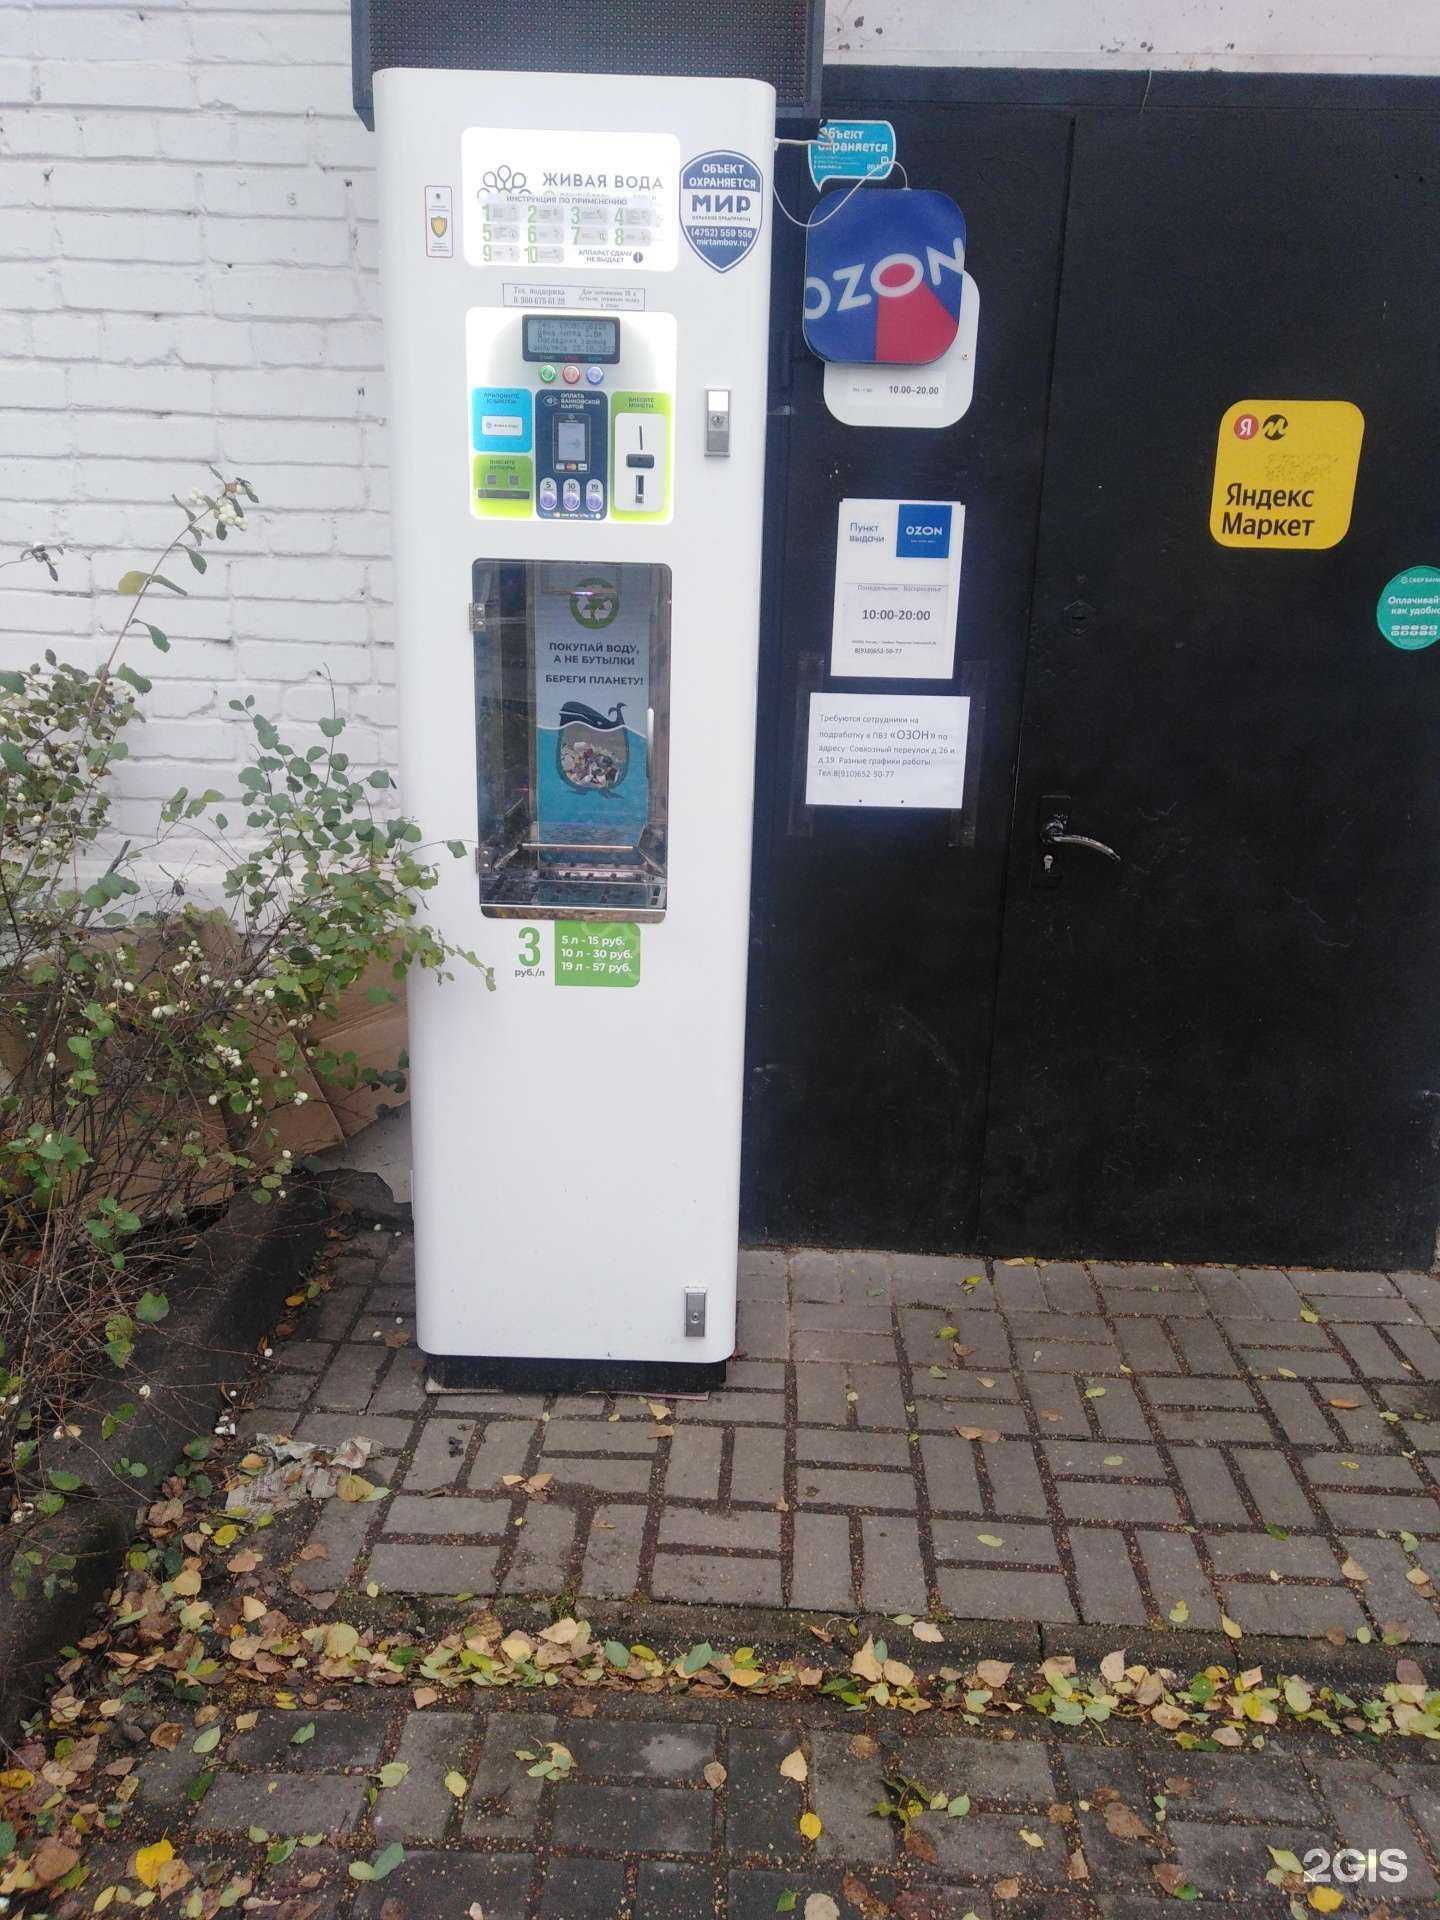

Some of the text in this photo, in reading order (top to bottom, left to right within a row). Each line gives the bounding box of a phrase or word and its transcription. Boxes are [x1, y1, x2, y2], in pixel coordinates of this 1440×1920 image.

[817, 142, 888, 154] раняется
[702, 163, 744, 174] ОБЪЕКТ
[542, 172, 664, 192] ЖИВАЯ ВОДА
[689, 176, 756, 190] ОХРАНЯЕТСЯ
[506, 194, 557, 204] ИНСТРУКЦИЯ
[558, 196, 570, 205] ПО
[573, 197, 628, 206] ПРИМЕНЕНИЮ
[691, 194, 752, 213] МИР
[482, 205, 492, 222] 1
[527, 205, 538, 223] 2
[570, 206, 581, 225] 3
[614, 207, 625, 226] 4
[482, 223, 493, 242] 5
[527, 225, 538, 243] 6
[570, 226, 581, 245] 7
[614, 227, 625, 246] 8
[691, 228, 718, 238] (4752)
[696, 238, 748, 247] mirtambov.ru
[482, 244, 493, 263] 9
[524, 246, 538, 264] 10
[805, 237, 965, 320] OZON
[1226, 483, 1315, 510] Яндекс
[850, 522, 880, 534] Пункт
[905, 526, 943, 536] OZON
[1222, 511, 1316, 539] Маркет
[849, 535, 885, 544] выдачи
[862, 609, 931, 621] 10:00-20:00
[1392, 607, 1408, 615] как
[549, 641, 640, 655] ПОКУПАЙ ВОДУ,
[553, 655, 635, 665] А НЕ БУТЫЛКИ
[545, 674, 644, 686] БЕРЕГИ ПЛАНЕТУ!
[820, 714, 861, 725] Требуются
[862, 715, 907, 725] сотрудники
[819, 731, 864, 740] подработку
[872, 732, 888, 740] ПВЗ
[890, 729, 935, 741] «ОЗОН»
[849, 744, 892, 753] Совхозный
[893, 747, 930, 755] переулок
[838, 757, 867, 765] Разные
[868, 758, 901, 767] графики
[518, 926, 541, 967] 3
[561, 935, 569, 945] 5
[571, 936, 579, 945] л
[587, 935, 600, 945] 15
[602, 937, 626, 948] руб.
[561, 948, 574, 958] 10
[593, 949, 607, 958] 30
[609, 950, 634, 959] руб.
[514, 968, 545, 978] руб./л
[561, 961, 573, 971] 19
[575, 963, 583, 971] л
[592, 963, 606, 972] 57
[608, 963, 633, 973] руб.
